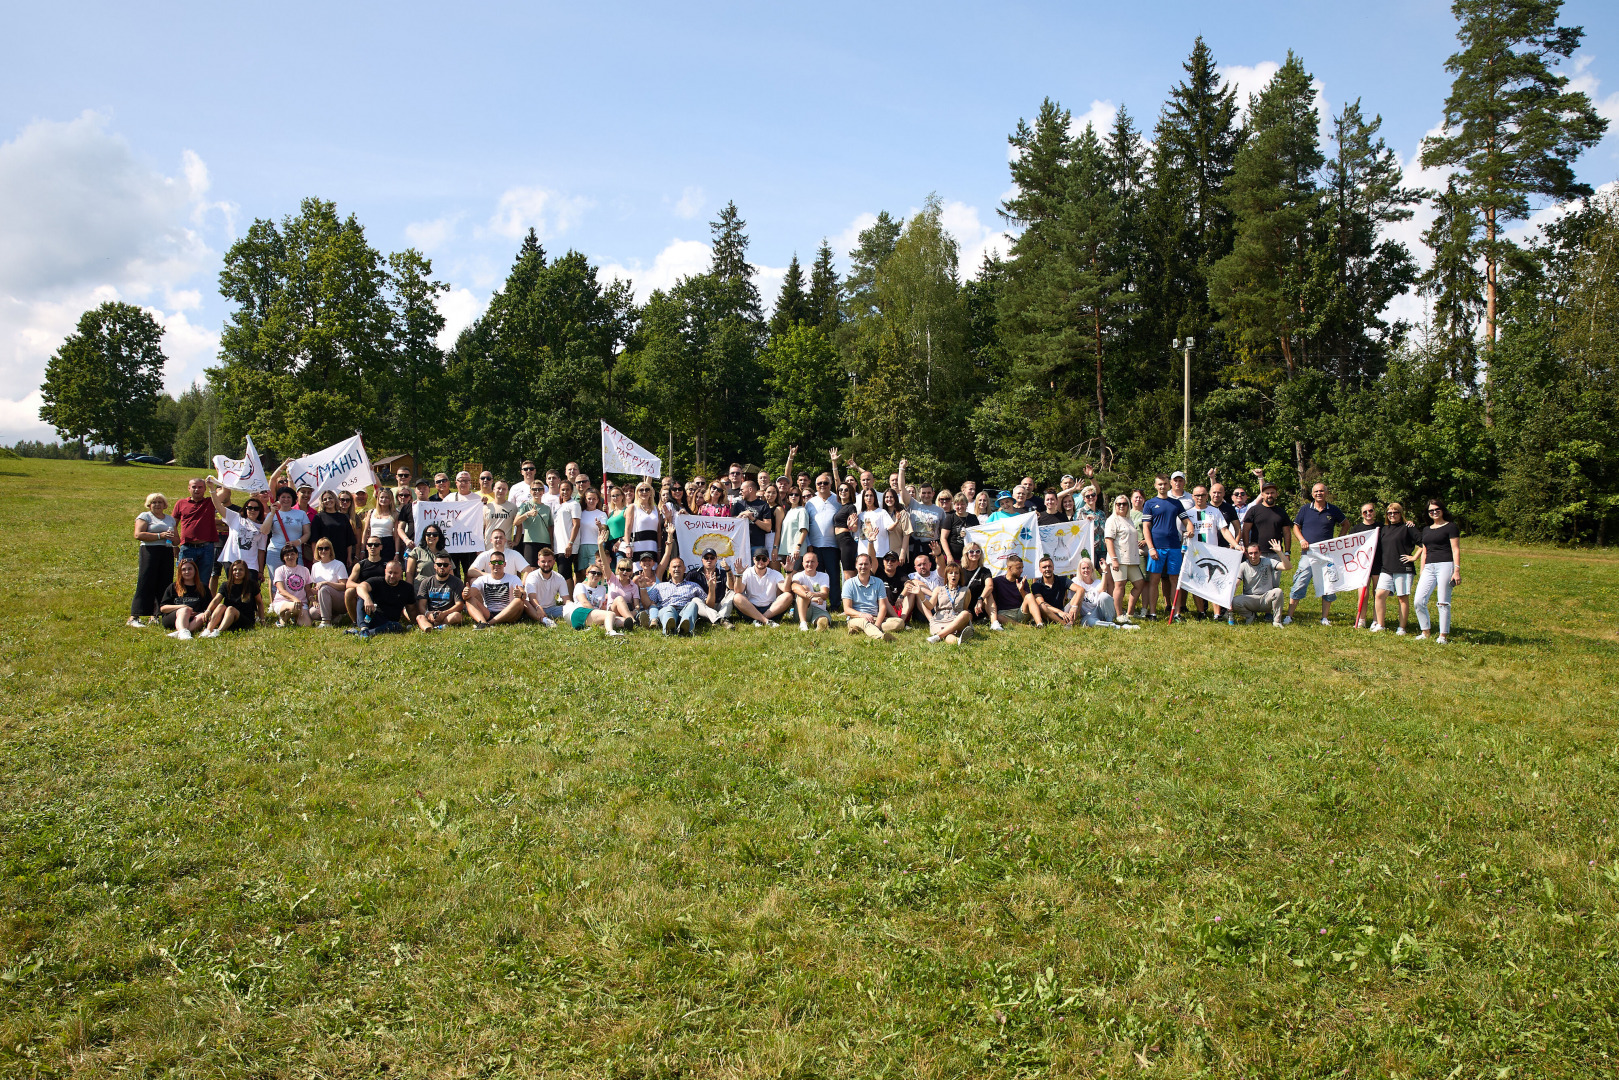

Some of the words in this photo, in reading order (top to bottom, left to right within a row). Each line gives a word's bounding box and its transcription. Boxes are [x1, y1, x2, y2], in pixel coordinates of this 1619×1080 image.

[616, 446, 655, 474] ПАТРУЛЬ
[684, 520, 735, 532] ВЯЛЕНЫЙ
[1319, 535, 1366, 554] ВЕСЕЛО
